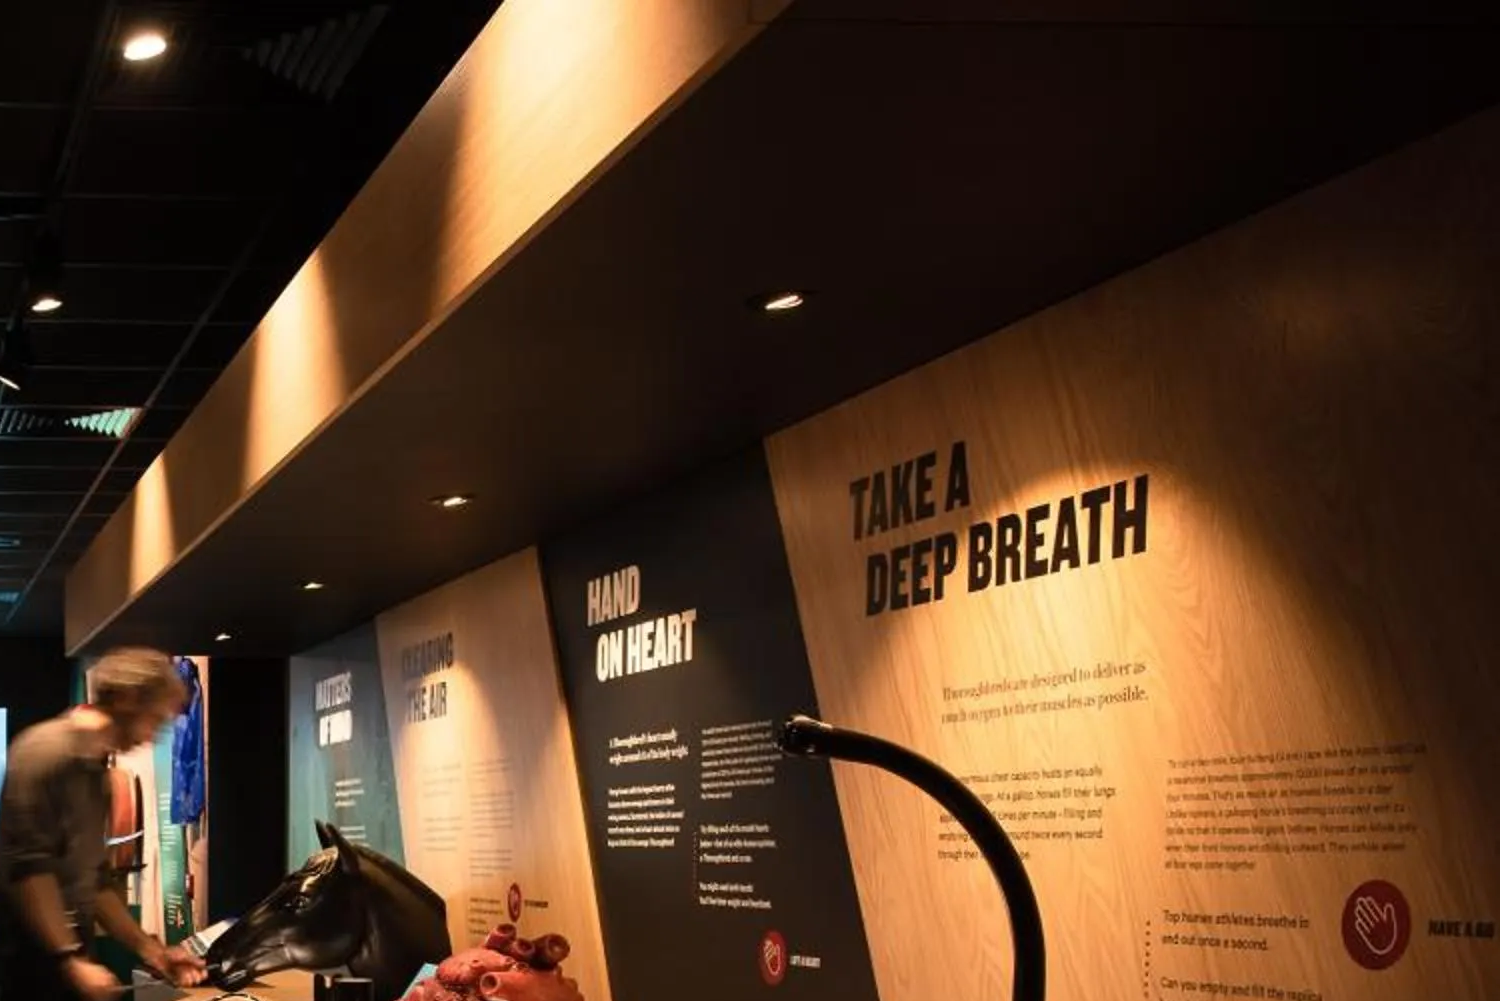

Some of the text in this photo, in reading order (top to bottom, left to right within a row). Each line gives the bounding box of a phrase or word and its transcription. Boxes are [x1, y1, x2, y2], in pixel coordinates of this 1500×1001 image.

[850, 440, 970, 541] TAKE A
[866, 473, 1149, 617] DEEP BREATH
[587, 564, 641, 627] HAND
[596, 607, 697, 683] ON HEART
[1030, 668, 1077, 689] designed
[1079, 668, 1091, 681] to
[1092, 661, 1131, 680] deliver
[1132, 662, 1146, 674] as
[404, 681, 447, 725] THE AIR
[1097, 685, 1150, 711] possible.
[1093, 784, 1116, 801] lungs
[1087, 807, 1103, 819] and
[1163, 909, 1310, 929] Top human athletes breathe in
[1428, 919, 1462, 937] HAVE
[1464, 920, 1473, 938] A
[1162, 933, 1179, 945] and
[1181, 934, 1196, 946] out
[1198, 936, 1221, 948] once
[1231, 937, 1268, 951] second.
[1160, 976, 1179, 989] Can
[1180, 979, 1197, 993] you
[1200, 981, 1228, 996] empty
[1231, 983, 1250, 997] and
[1251, 983, 1265, 998] fill
[1267, 986, 1285, 1000] the
